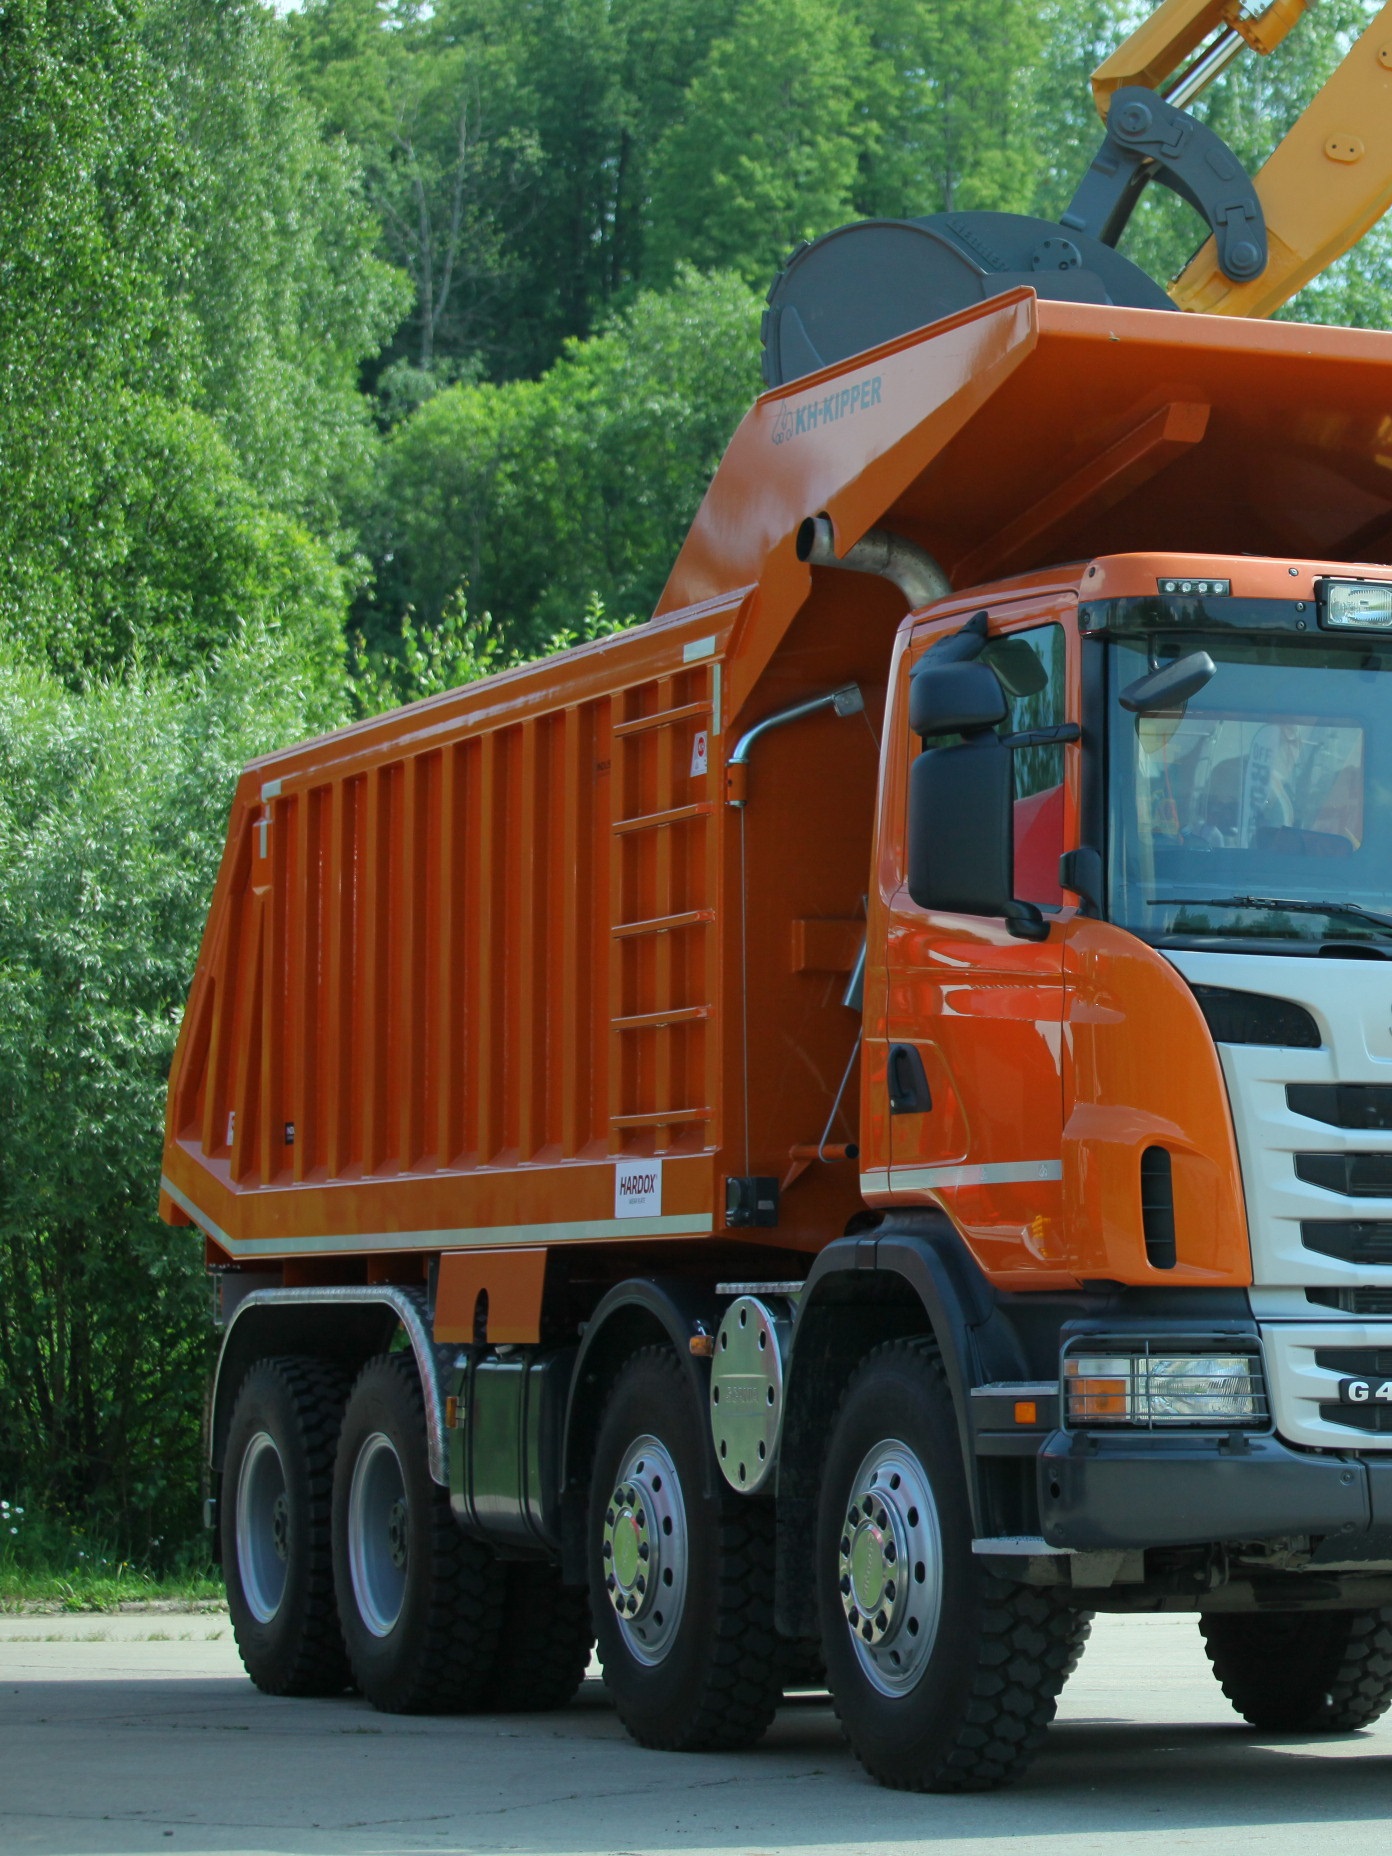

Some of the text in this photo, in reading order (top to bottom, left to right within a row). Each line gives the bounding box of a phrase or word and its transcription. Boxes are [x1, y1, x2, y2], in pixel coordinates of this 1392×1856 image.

[795, 376, 882, 435] KH-KIPPER
[620, 1174, 656, 1195] HARDOX
[1348, 1381, 1369, 1402] G
